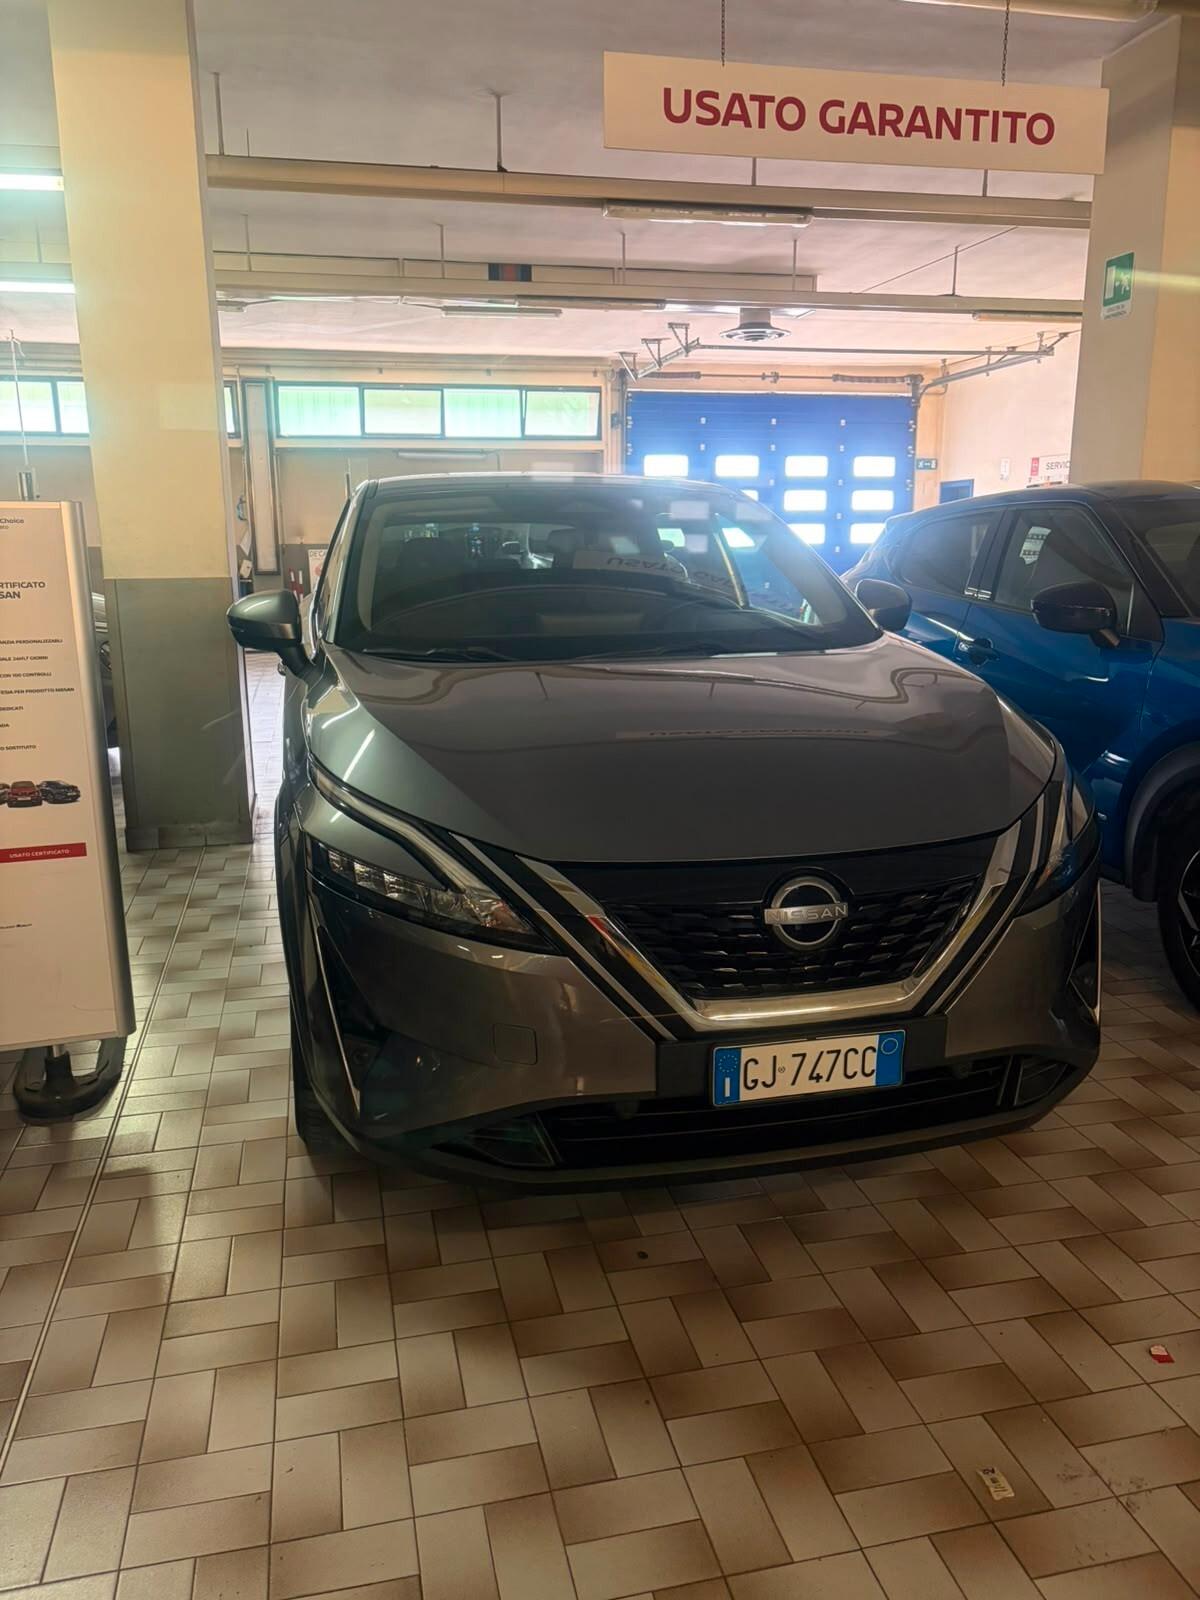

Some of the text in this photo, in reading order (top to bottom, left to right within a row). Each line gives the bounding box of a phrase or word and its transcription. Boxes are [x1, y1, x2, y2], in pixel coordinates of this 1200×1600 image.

[662, 87, 1056, 146] USATO GARANTITO
[766, 904, 847, 921] NISSAN
[790, 1045, 877, 1087] 747CC
